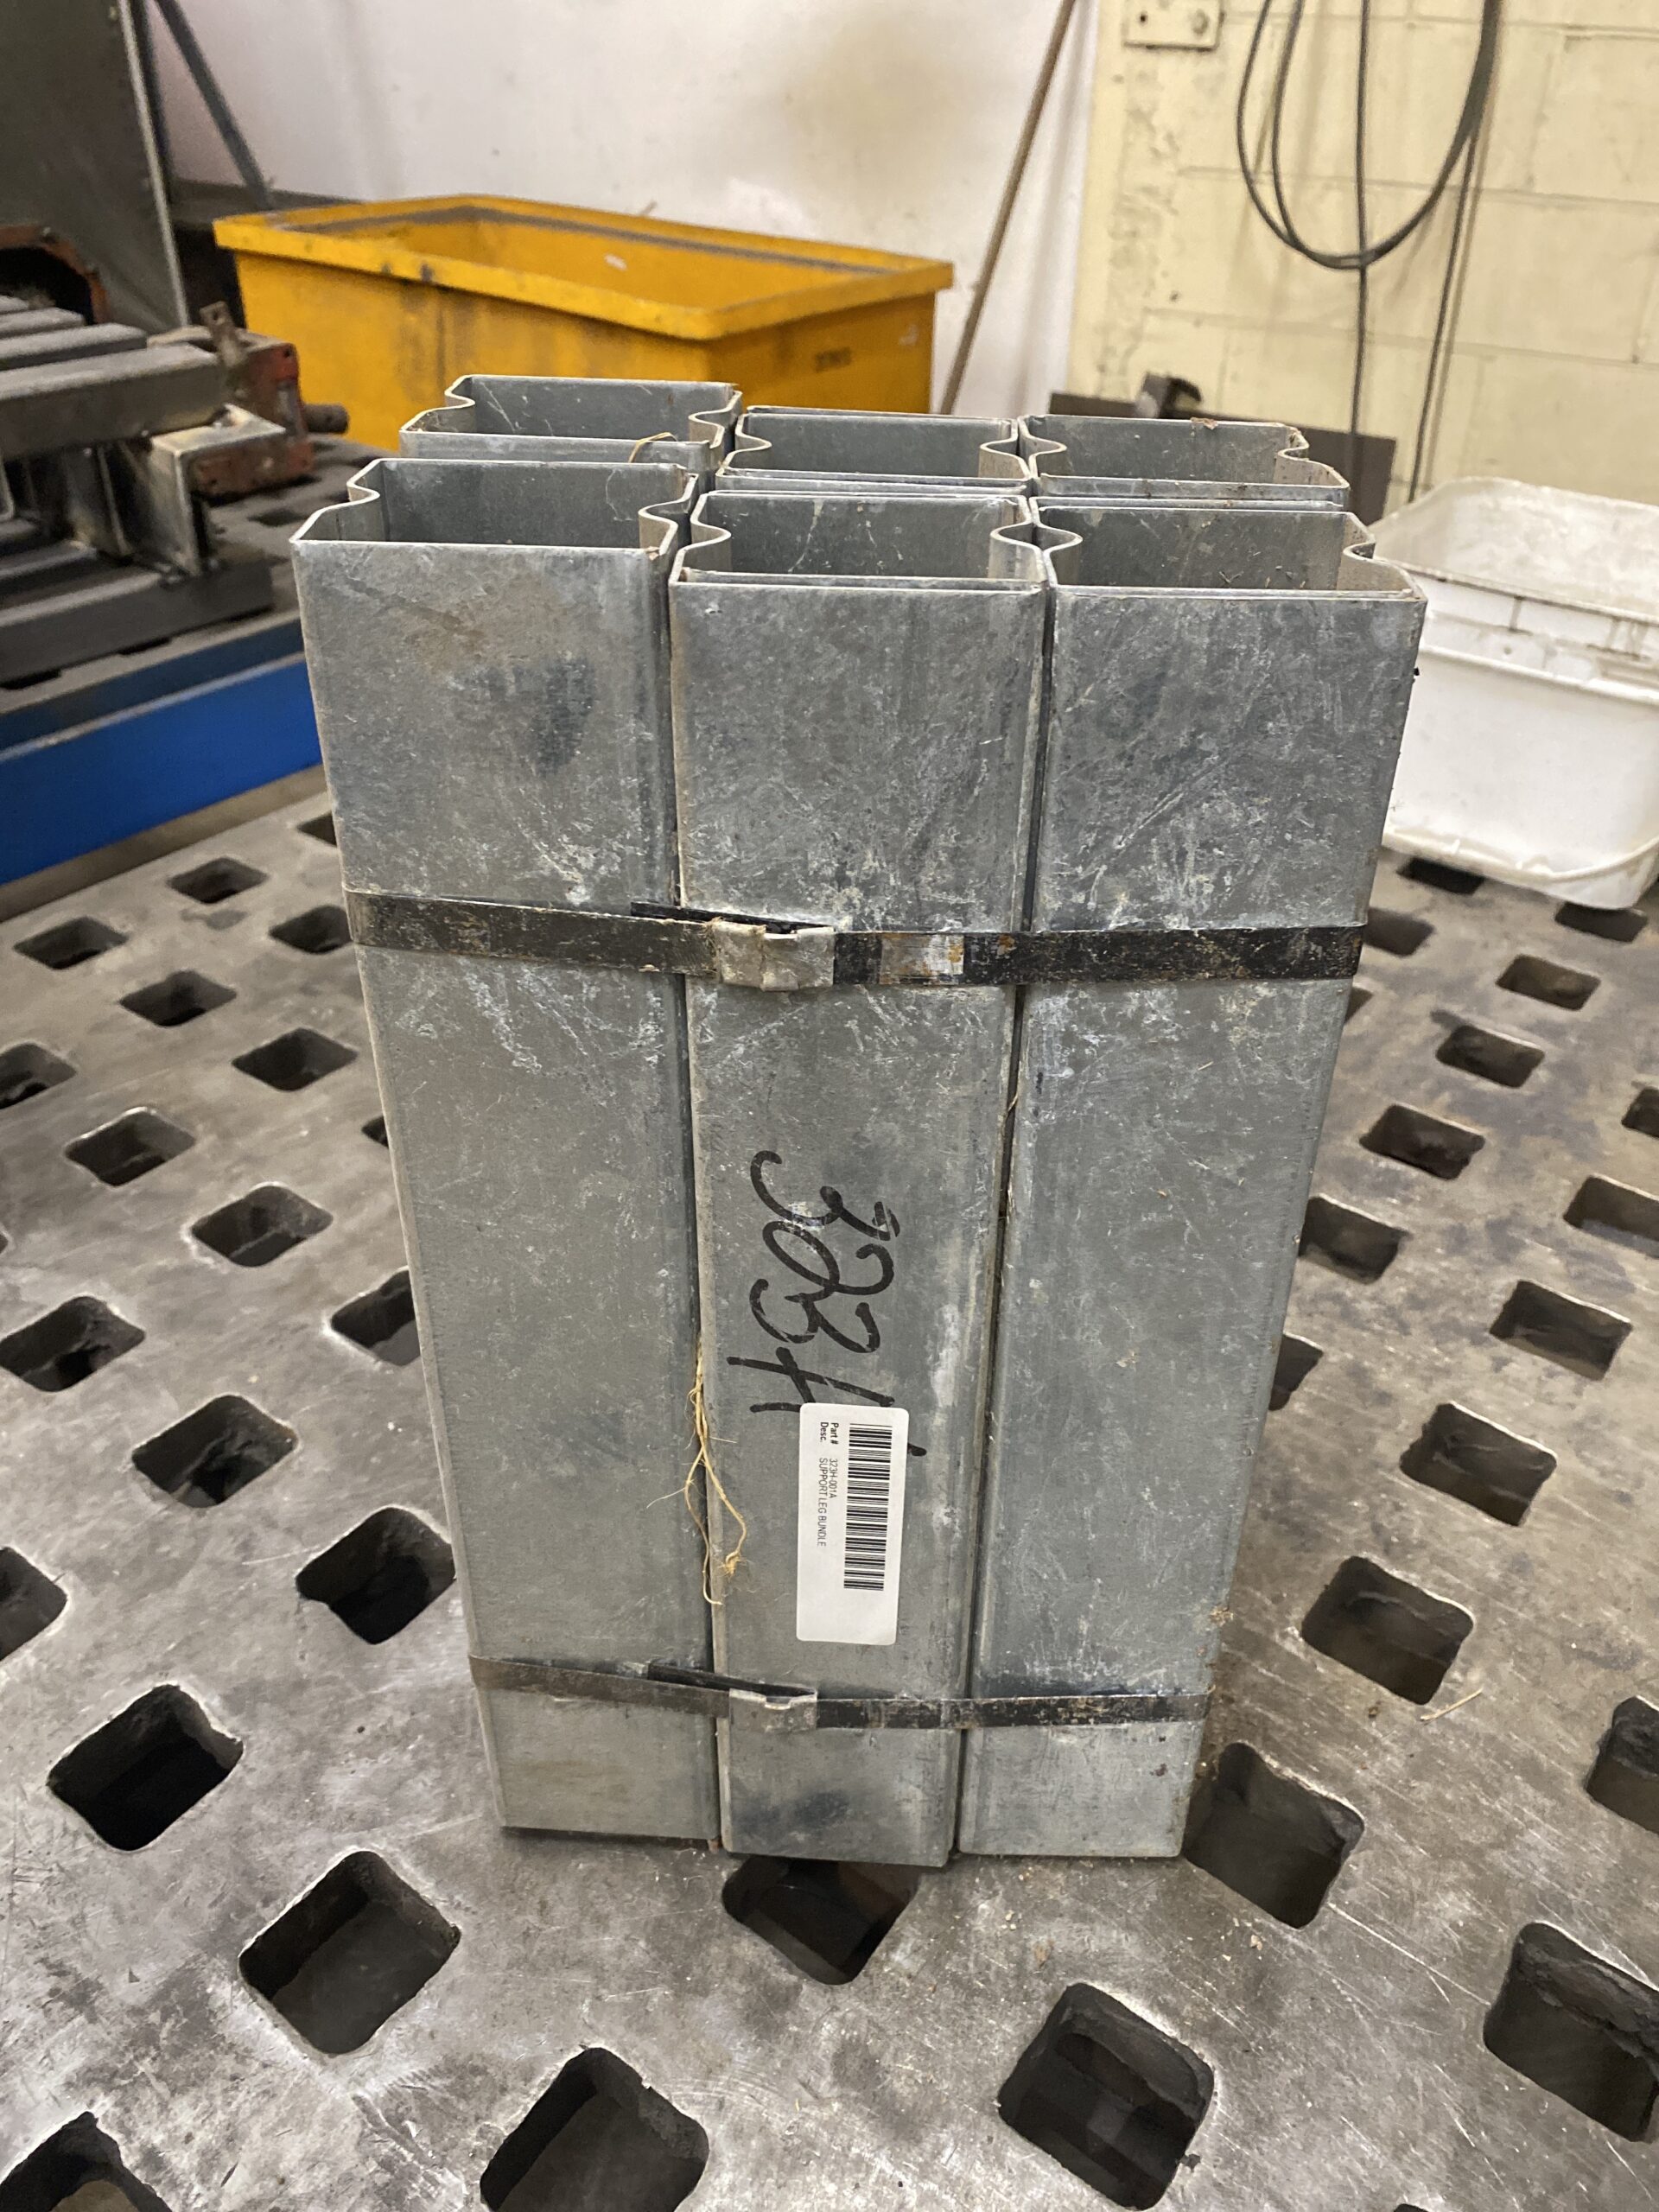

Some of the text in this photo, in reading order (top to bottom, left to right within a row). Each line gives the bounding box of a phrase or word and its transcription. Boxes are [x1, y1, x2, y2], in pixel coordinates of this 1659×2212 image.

[830, 1422, 840, 1438] Part
[817, 1421, 830, 1547] Desc. SUPPORT LEG BUNDLE
[829, 1458, 838, 1499] 323H-001A
